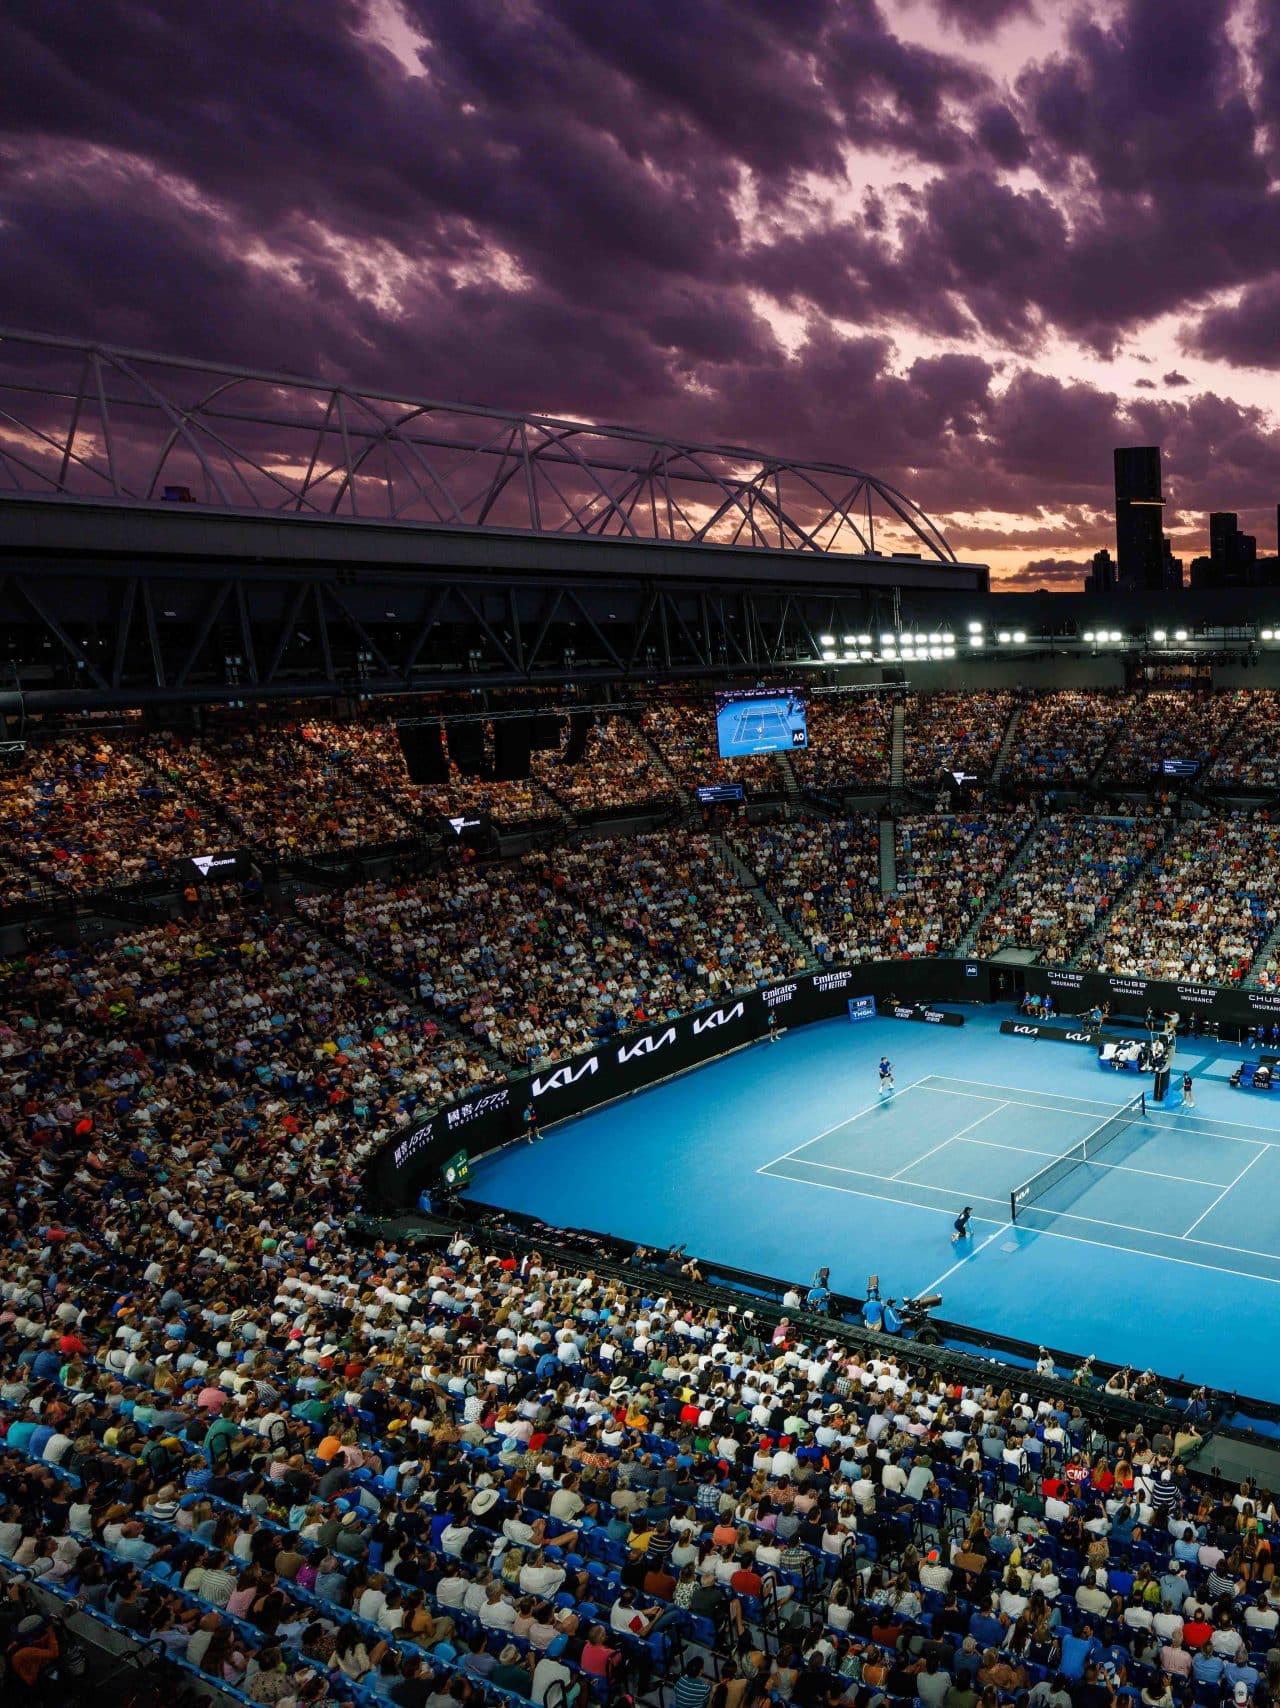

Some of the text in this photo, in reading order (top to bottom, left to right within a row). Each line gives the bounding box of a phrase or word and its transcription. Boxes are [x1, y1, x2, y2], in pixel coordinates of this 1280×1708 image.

[793, 733, 804, 742] AO
[813, 970, 853, 985] Emirates
[1047, 971, 1084, 981] CHUBB
[828, 979, 847, 990] BETTER
[1051, 980, 1081, 988] INSURANCE
[1109, 978, 1148, 988] CHUBB
[762, 984, 797, 1001] Emirates
[1113, 987, 1144, 996] INSURANCE
[1177, 986, 1217, 996] CHUBB
[1180, 995, 1214, 1004] INSURANCE
[692, 1001, 744, 1035] KIA
[1014, 1025, 1039, 1034] KIA
[1065, 1032, 1091, 1042] KIA
[618, 1027, 677, 1063] KIA
[532, 1056, 599, 1097] KIA
